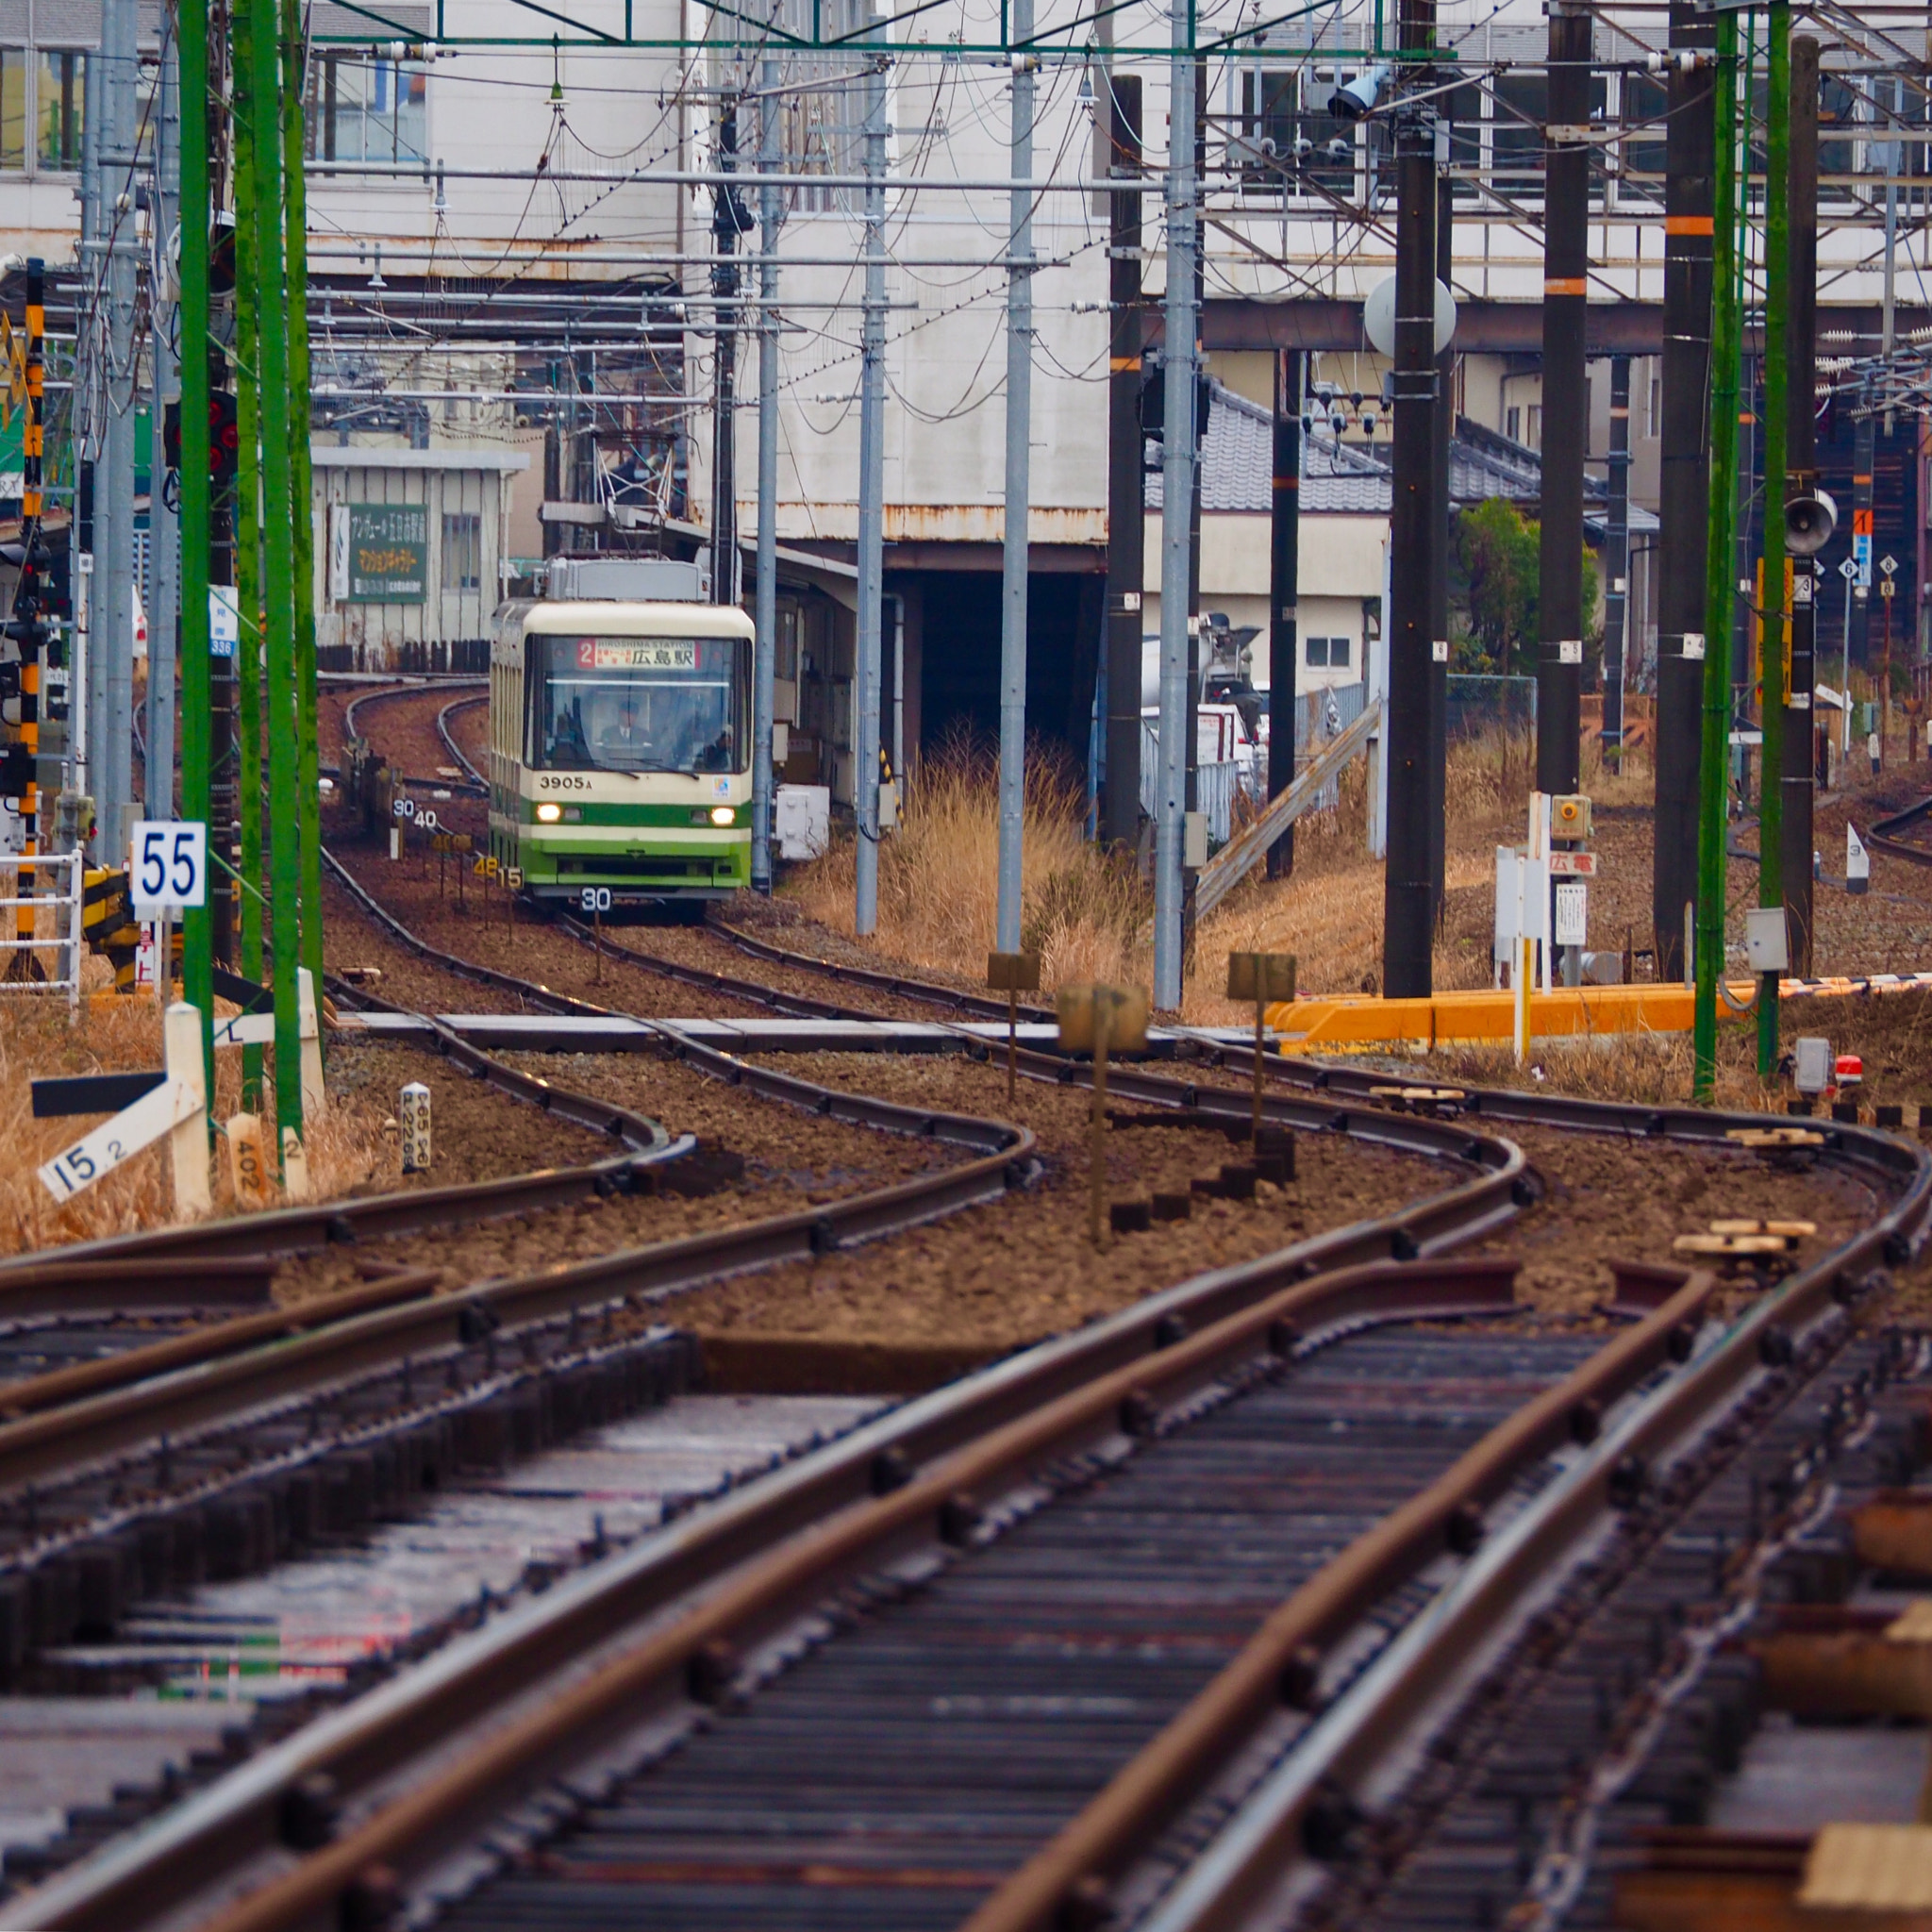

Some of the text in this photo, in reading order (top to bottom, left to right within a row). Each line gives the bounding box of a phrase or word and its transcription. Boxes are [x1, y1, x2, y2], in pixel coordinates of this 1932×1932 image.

[1845, 562, 1853, 575] 6
[1886, 559, 1891, 571] 8
[1803, 578, 1809, 591] 3
[211, 641, 231, 655] 336
[580, 642, 592, 663] 2
[597, 640, 693, 649] HIROSHIMA STATION
[1439, 643, 1443, 654] 6
[1573, 643, 1578, 655] 5
[632, 649, 693, 666] 広島駅
[540, 775, 592, 790] 3905A
[413, 810, 437, 828] 40
[142, 832, 195, 896] 55
[1550, 853, 1592, 873] 広電
[498, 868, 522, 889] 15
[582, 887, 611, 911] 30
[227, 1022, 243, 1042] L
[285, 1140, 301, 1159] 2
[237, 1140, 261, 1191] 402
